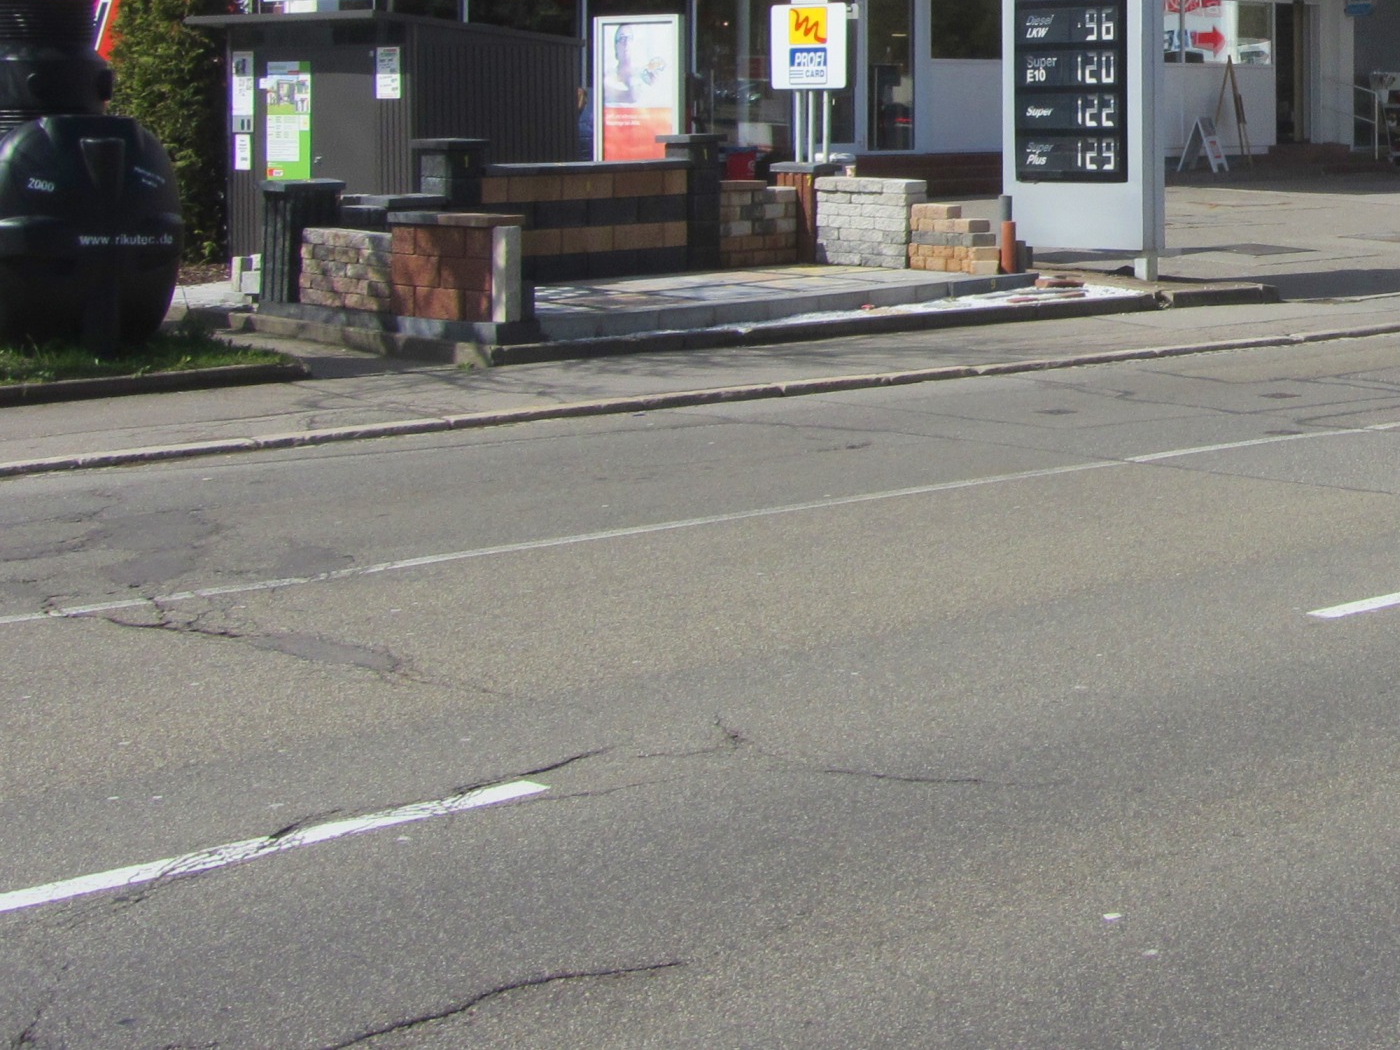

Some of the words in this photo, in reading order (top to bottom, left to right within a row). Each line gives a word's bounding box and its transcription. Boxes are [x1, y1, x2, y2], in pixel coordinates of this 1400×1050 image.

[1025, 14, 1055, 26] Diesel
[1025, 27, 1049, 38] LKW
[794, 51, 826, 67] PROFI
[1025, 54, 1058, 69] Super
[805, 69, 825, 78] CARD
[1026, 69, 1046, 82] E10
[1025, 106, 1055, 119] Super
[1077, 94, 1115, 127] 122
[1025, 142, 1055, 154] Super
[1025, 154, 1048, 165] Plus
[28, 177, 55, 192] 2000
